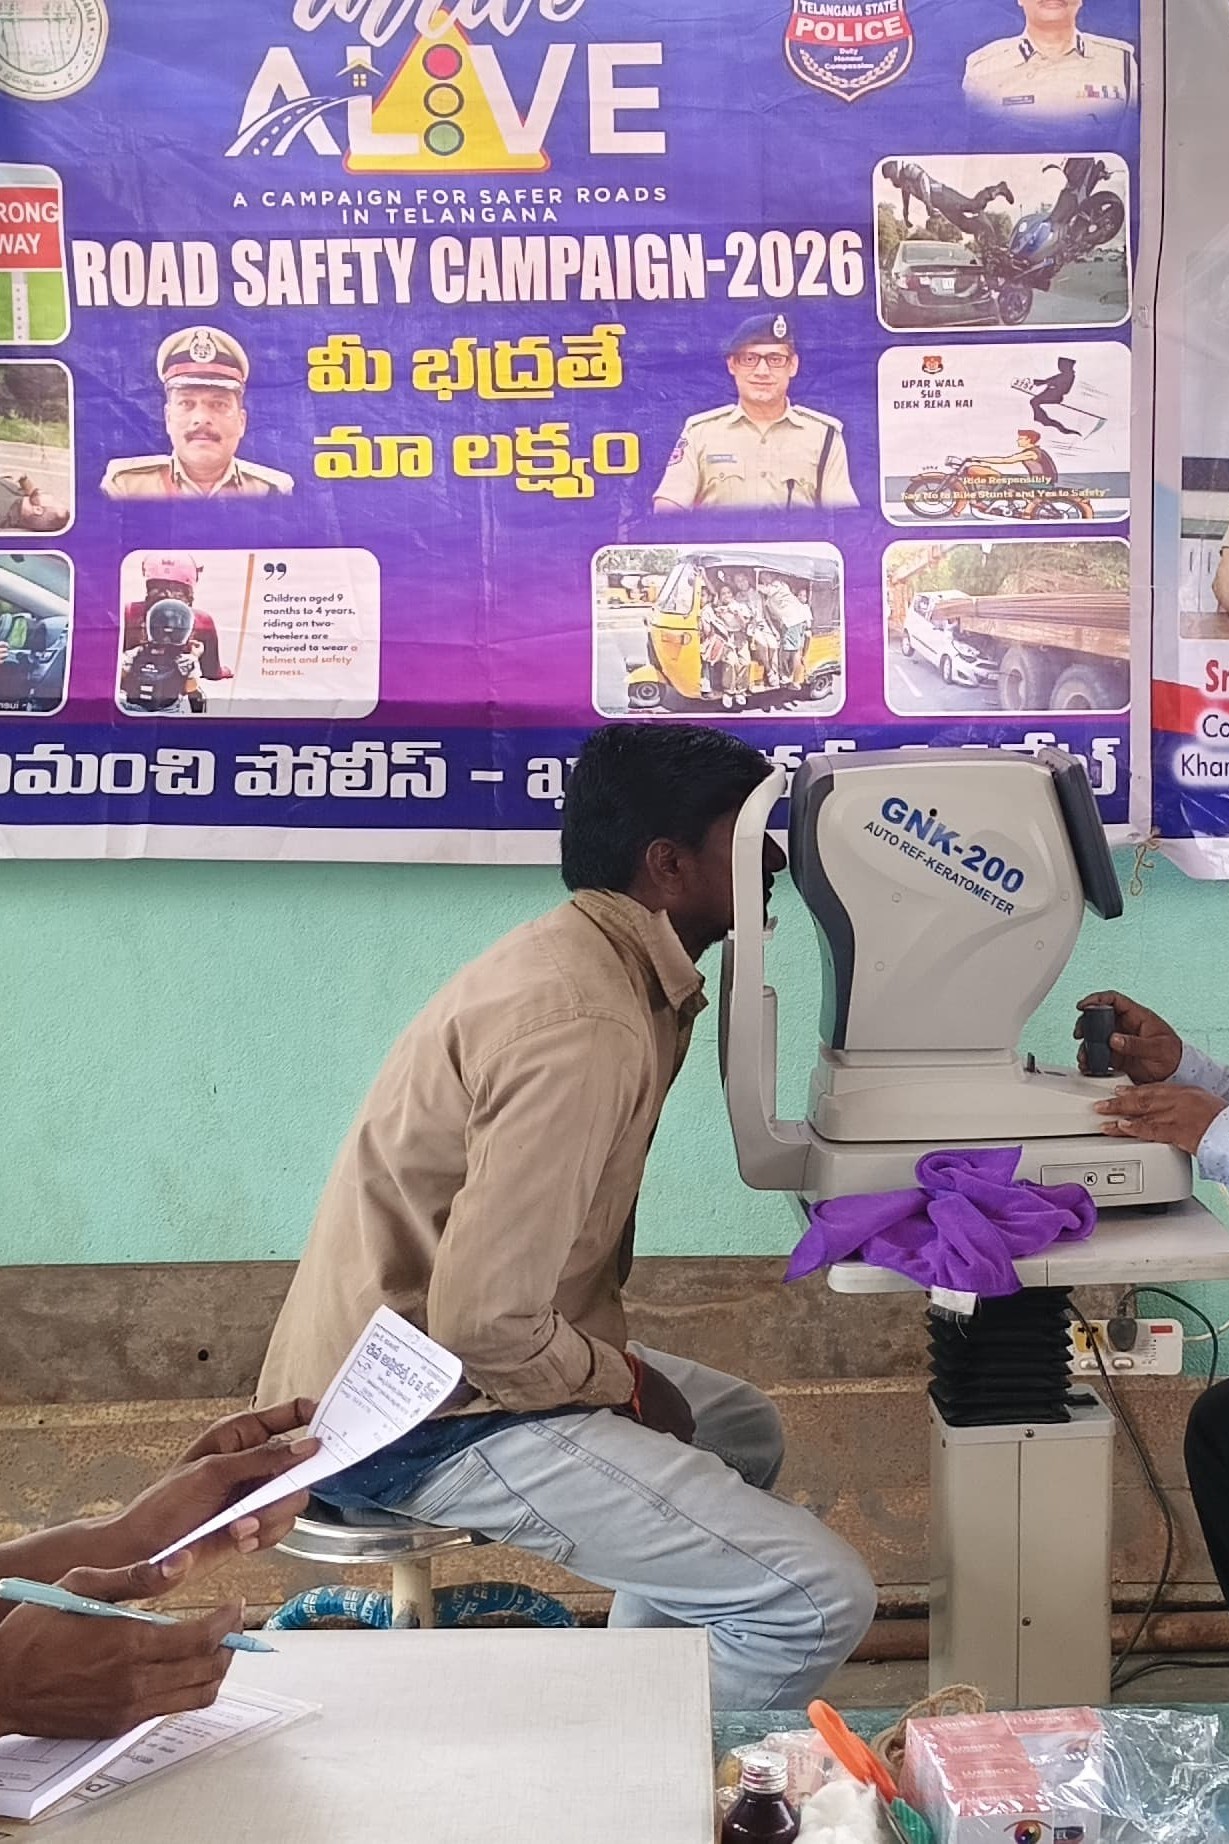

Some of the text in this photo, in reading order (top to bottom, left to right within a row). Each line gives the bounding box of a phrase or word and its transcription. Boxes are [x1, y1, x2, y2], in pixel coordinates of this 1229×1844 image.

[801, 0, 897, 16] TELANGANA STATE
[795, 16, 904, 42] POLICE
[233, 187, 667, 208] A CAMPAIGN FOR SAFER ROADS
[342, 207, 558, 225] IN TELANGANA
[71, 230, 865, 308] ROAD SAFETY CAMPAIGN-2026
[307, 323, 627, 401] మీ భద్రతే
[902, 378, 965, 389] UPAR WALA
[921, 390, 942, 398] SUB
[314, 423, 640, 498] మా లక్ష్యం
[988, 475, 1052, 486] Responsibly
[978, 489, 1013, 499] Stunts
[1015, 489, 1035, 499] and
[1037, 489, 1056, 498] Yes
[263, 593, 344, 604] Children aged 9
[263, 606, 300, 615] months
[303, 607, 313, 615] to
[316, 606, 322, 614] 4
[263, 619, 293, 629] riding
[263, 632, 309, 640] wheelers
[262, 643, 307, 653] required
[262, 654, 352, 665] helmet and safety
[234, 741, 447, 799] పోలీస్
[863, 821, 1015, 916] AUTO REF-KERATOMETER
